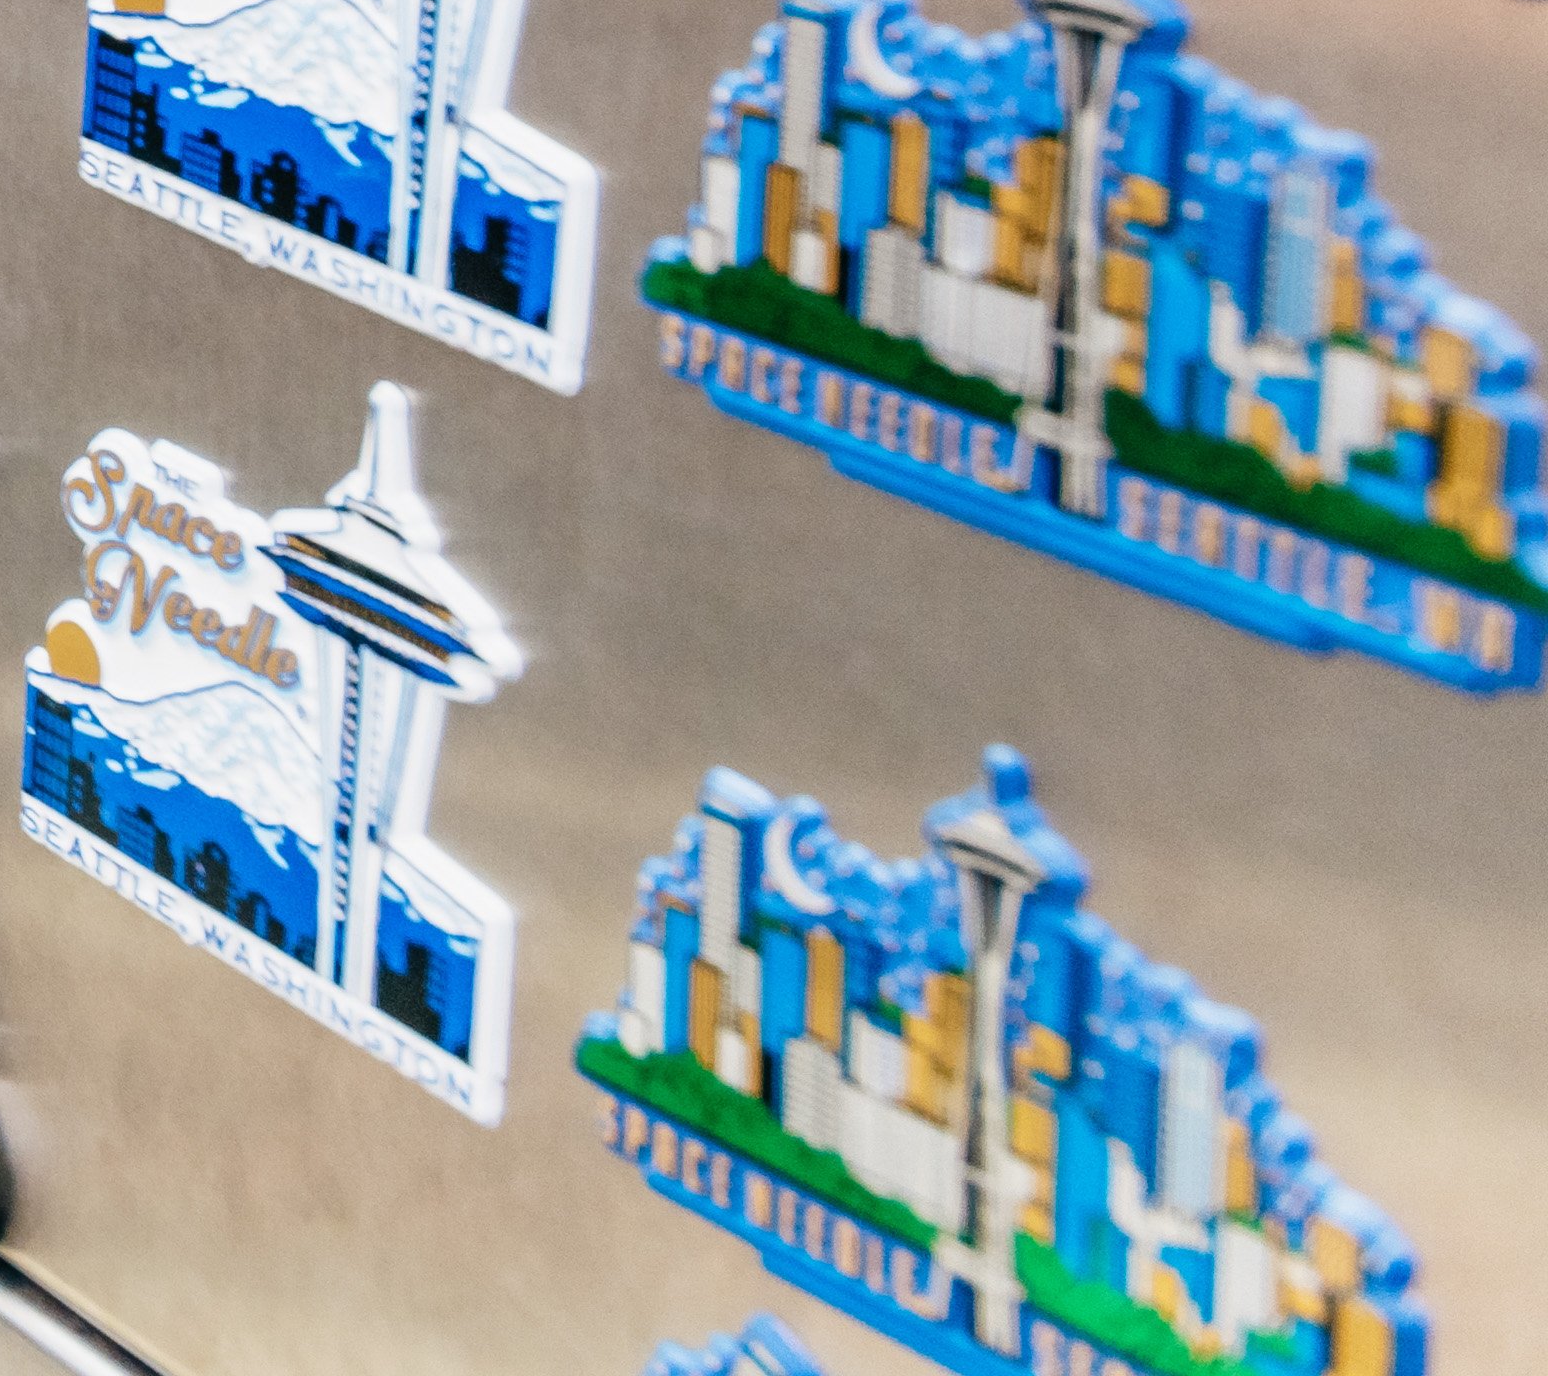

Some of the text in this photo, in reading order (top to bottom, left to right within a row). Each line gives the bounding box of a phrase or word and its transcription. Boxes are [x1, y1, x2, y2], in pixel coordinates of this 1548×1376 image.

[81, 152, 553, 376] SEATTLE, WASHINGTON
[658, 311, 804, 413] SPACE
[64, 450, 244, 573] Space
[84, 542, 300, 690] Needle
[20, 805, 473, 1106] SEATTLE, WASHINGTON
[599, 1095, 734, 1208] SPACE
